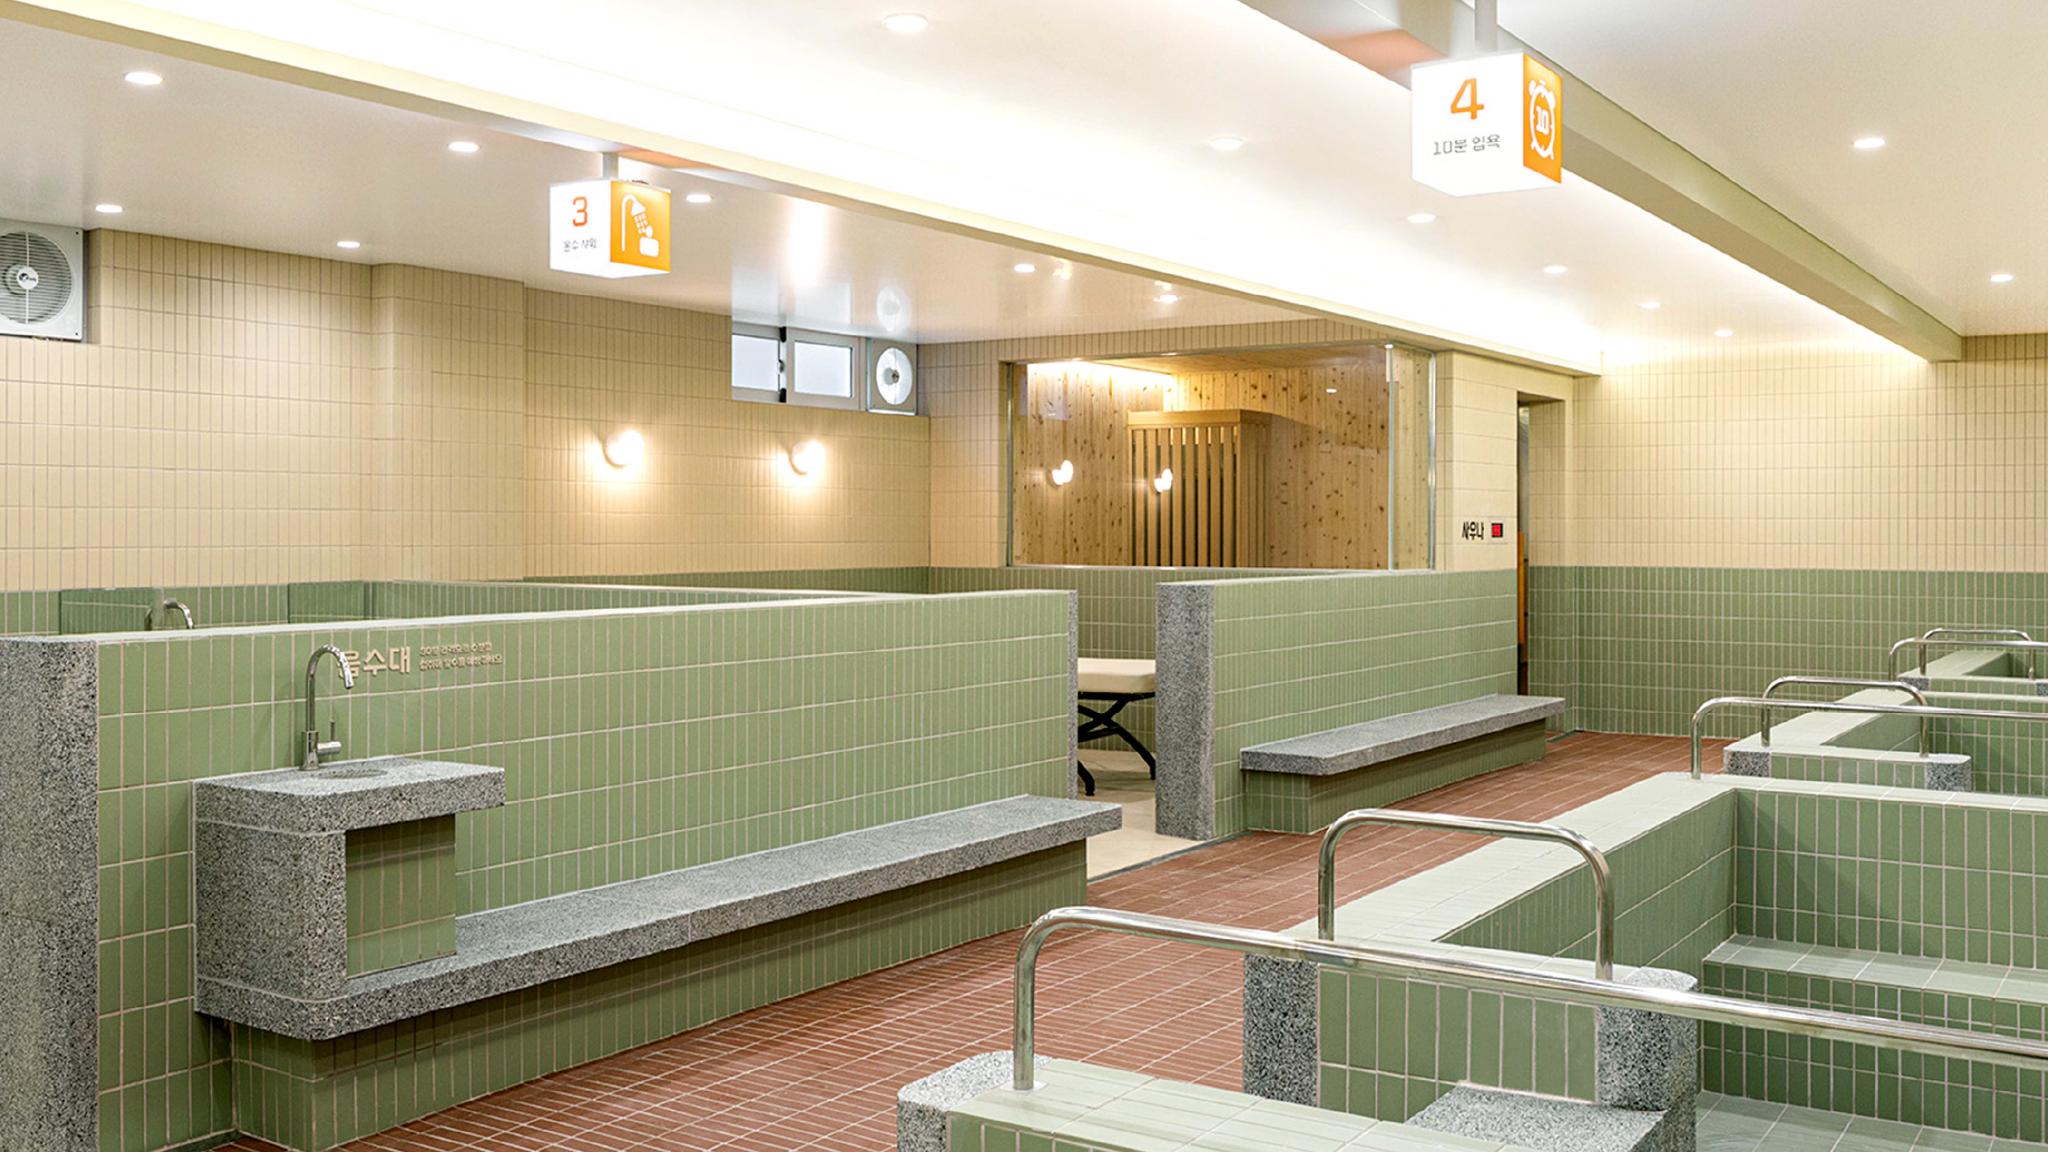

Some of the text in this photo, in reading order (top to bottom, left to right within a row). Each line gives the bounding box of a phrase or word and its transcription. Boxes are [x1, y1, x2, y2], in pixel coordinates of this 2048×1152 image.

[1450, 77, 1485, 121] 4
[1535, 105, 1550, 136] 10
[1433, 134, 1501, 156] 10분 입욕
[572, 195, 589, 227] 3
[1461, 521, 1485, 541] 사우나
